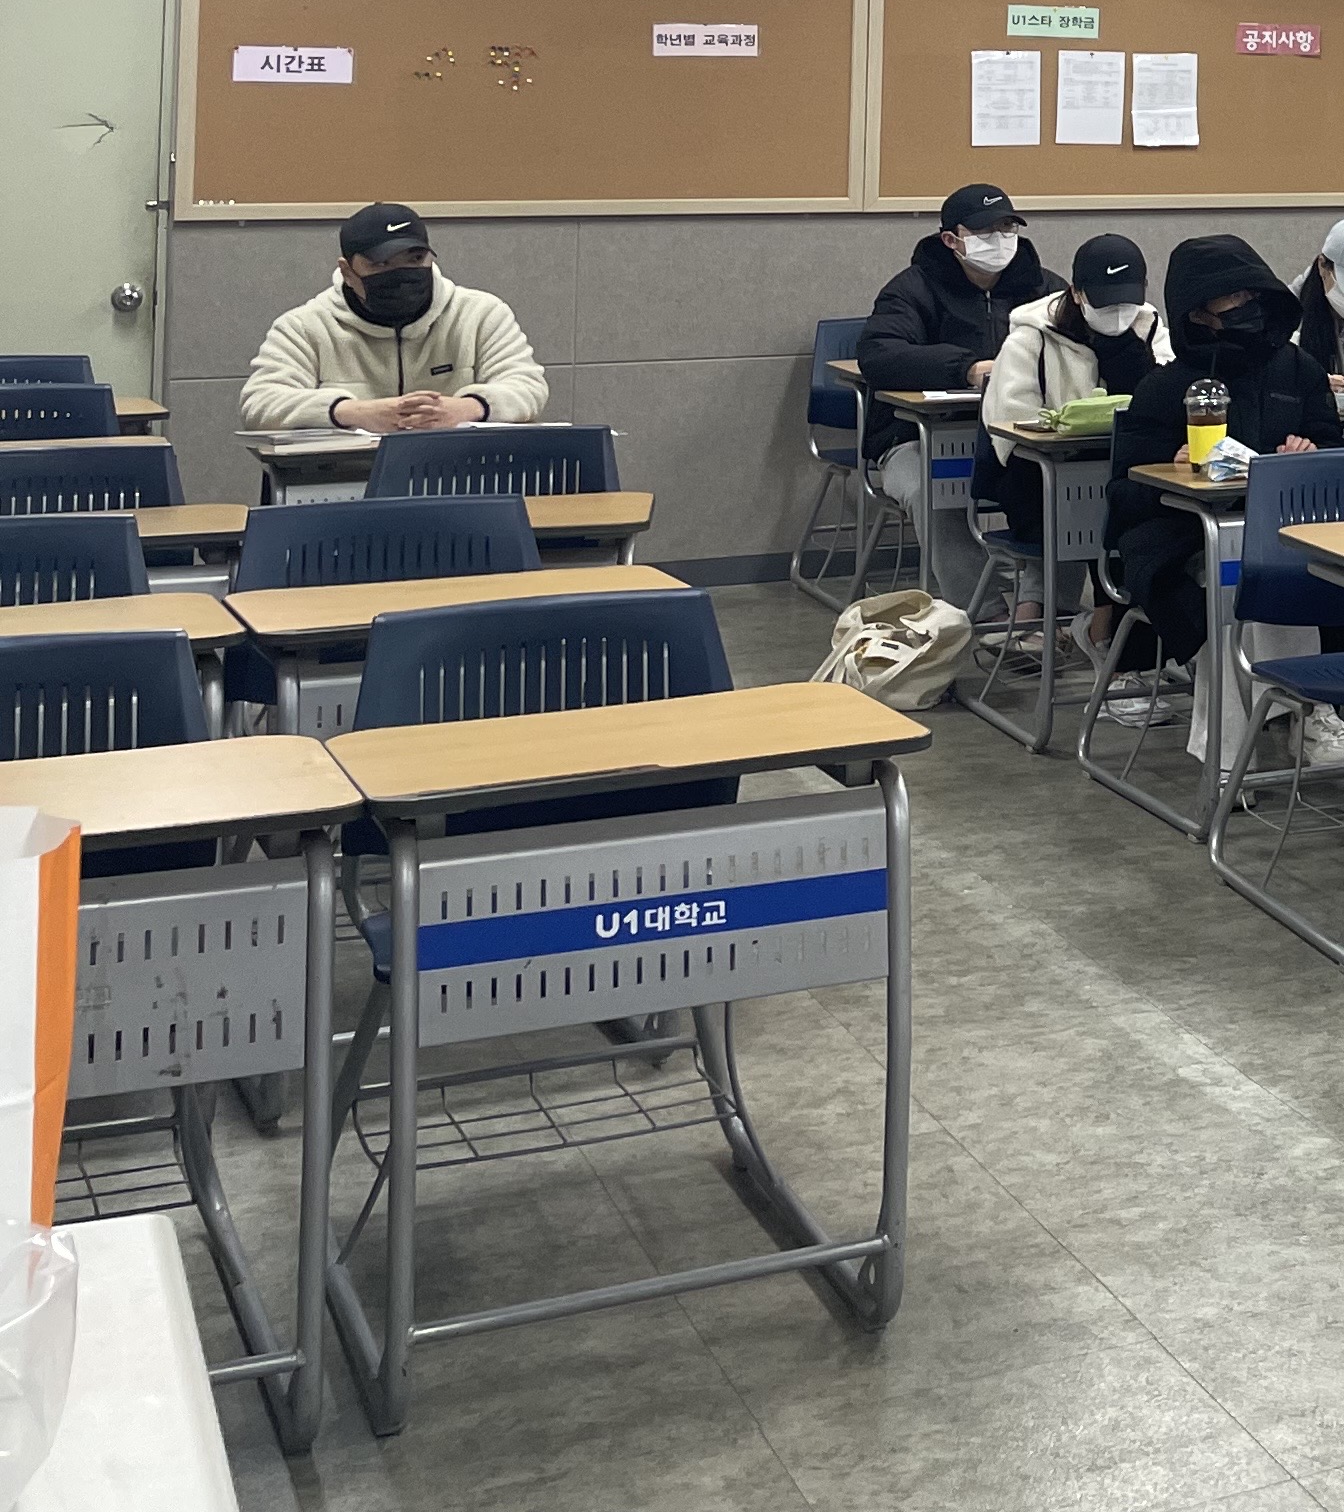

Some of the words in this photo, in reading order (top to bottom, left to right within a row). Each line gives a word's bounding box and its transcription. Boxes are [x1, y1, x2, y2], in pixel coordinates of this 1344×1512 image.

[1011, 14, 1053, 28] U1스타
[1059, 15, 1095, 30] 장학금
[655, 33, 696, 47] 학년별
[702, 33, 756, 48] 교육과정
[1242, 29, 1315, 52] 공지사항
[260, 52, 327, 74] 시간표
[595, 900, 727, 938] U1대학교
